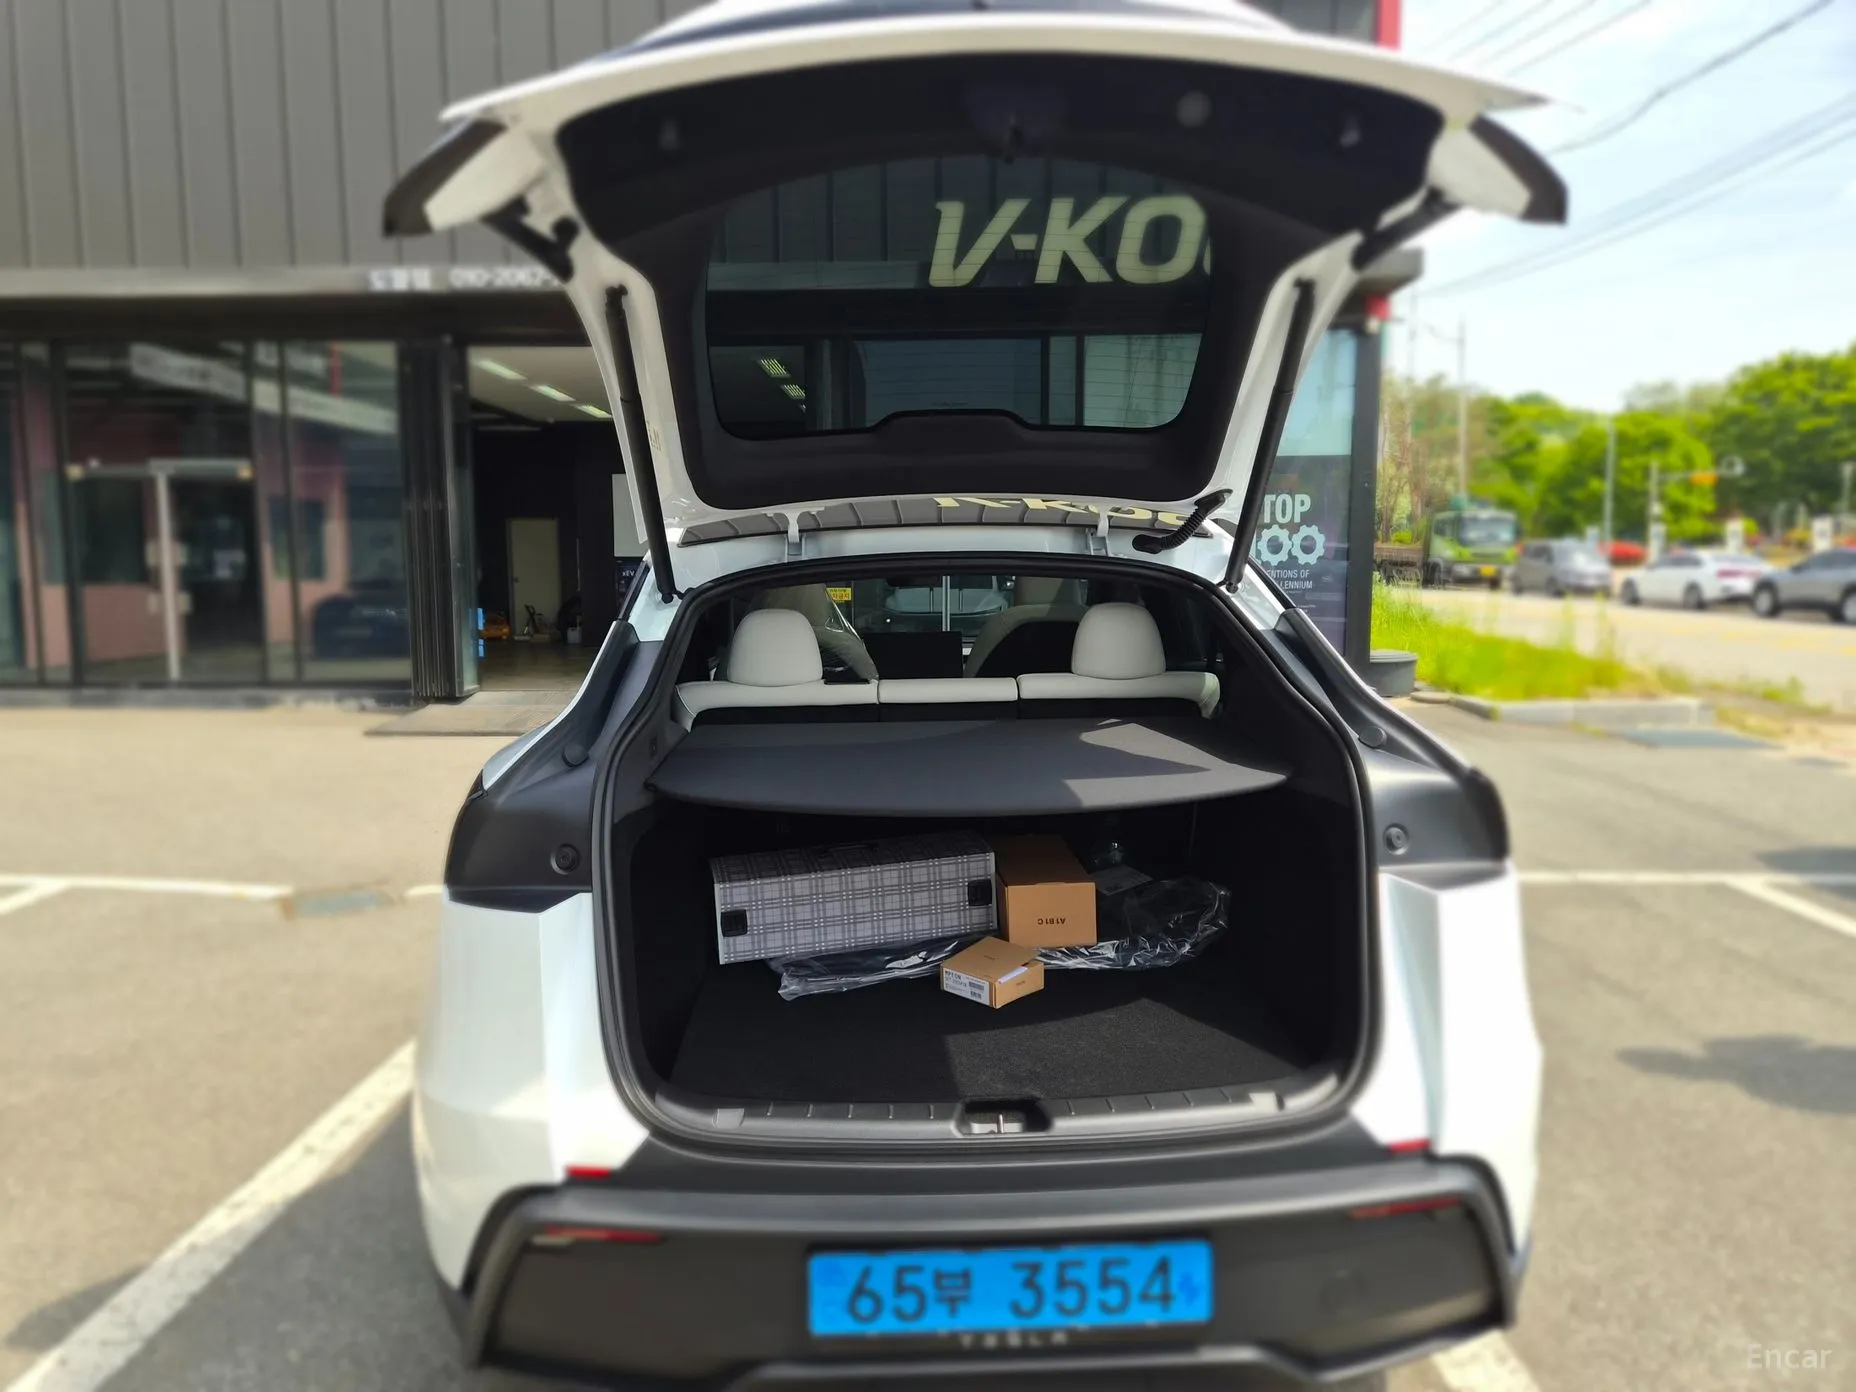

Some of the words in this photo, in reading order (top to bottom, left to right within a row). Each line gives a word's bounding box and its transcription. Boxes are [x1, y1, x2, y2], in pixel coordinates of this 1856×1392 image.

[928, 195, 1212, 287] V-KO
[1264, 494, 1311, 523] TOP
[1266, 569, 1298, 579] ENTIONS
[1300, 569, 1310, 578] OF
[1276, 580, 1313, 589] LENNIUM
[847, 1265, 973, 1325] 65부
[1009, 1256, 1176, 1318] 3554
